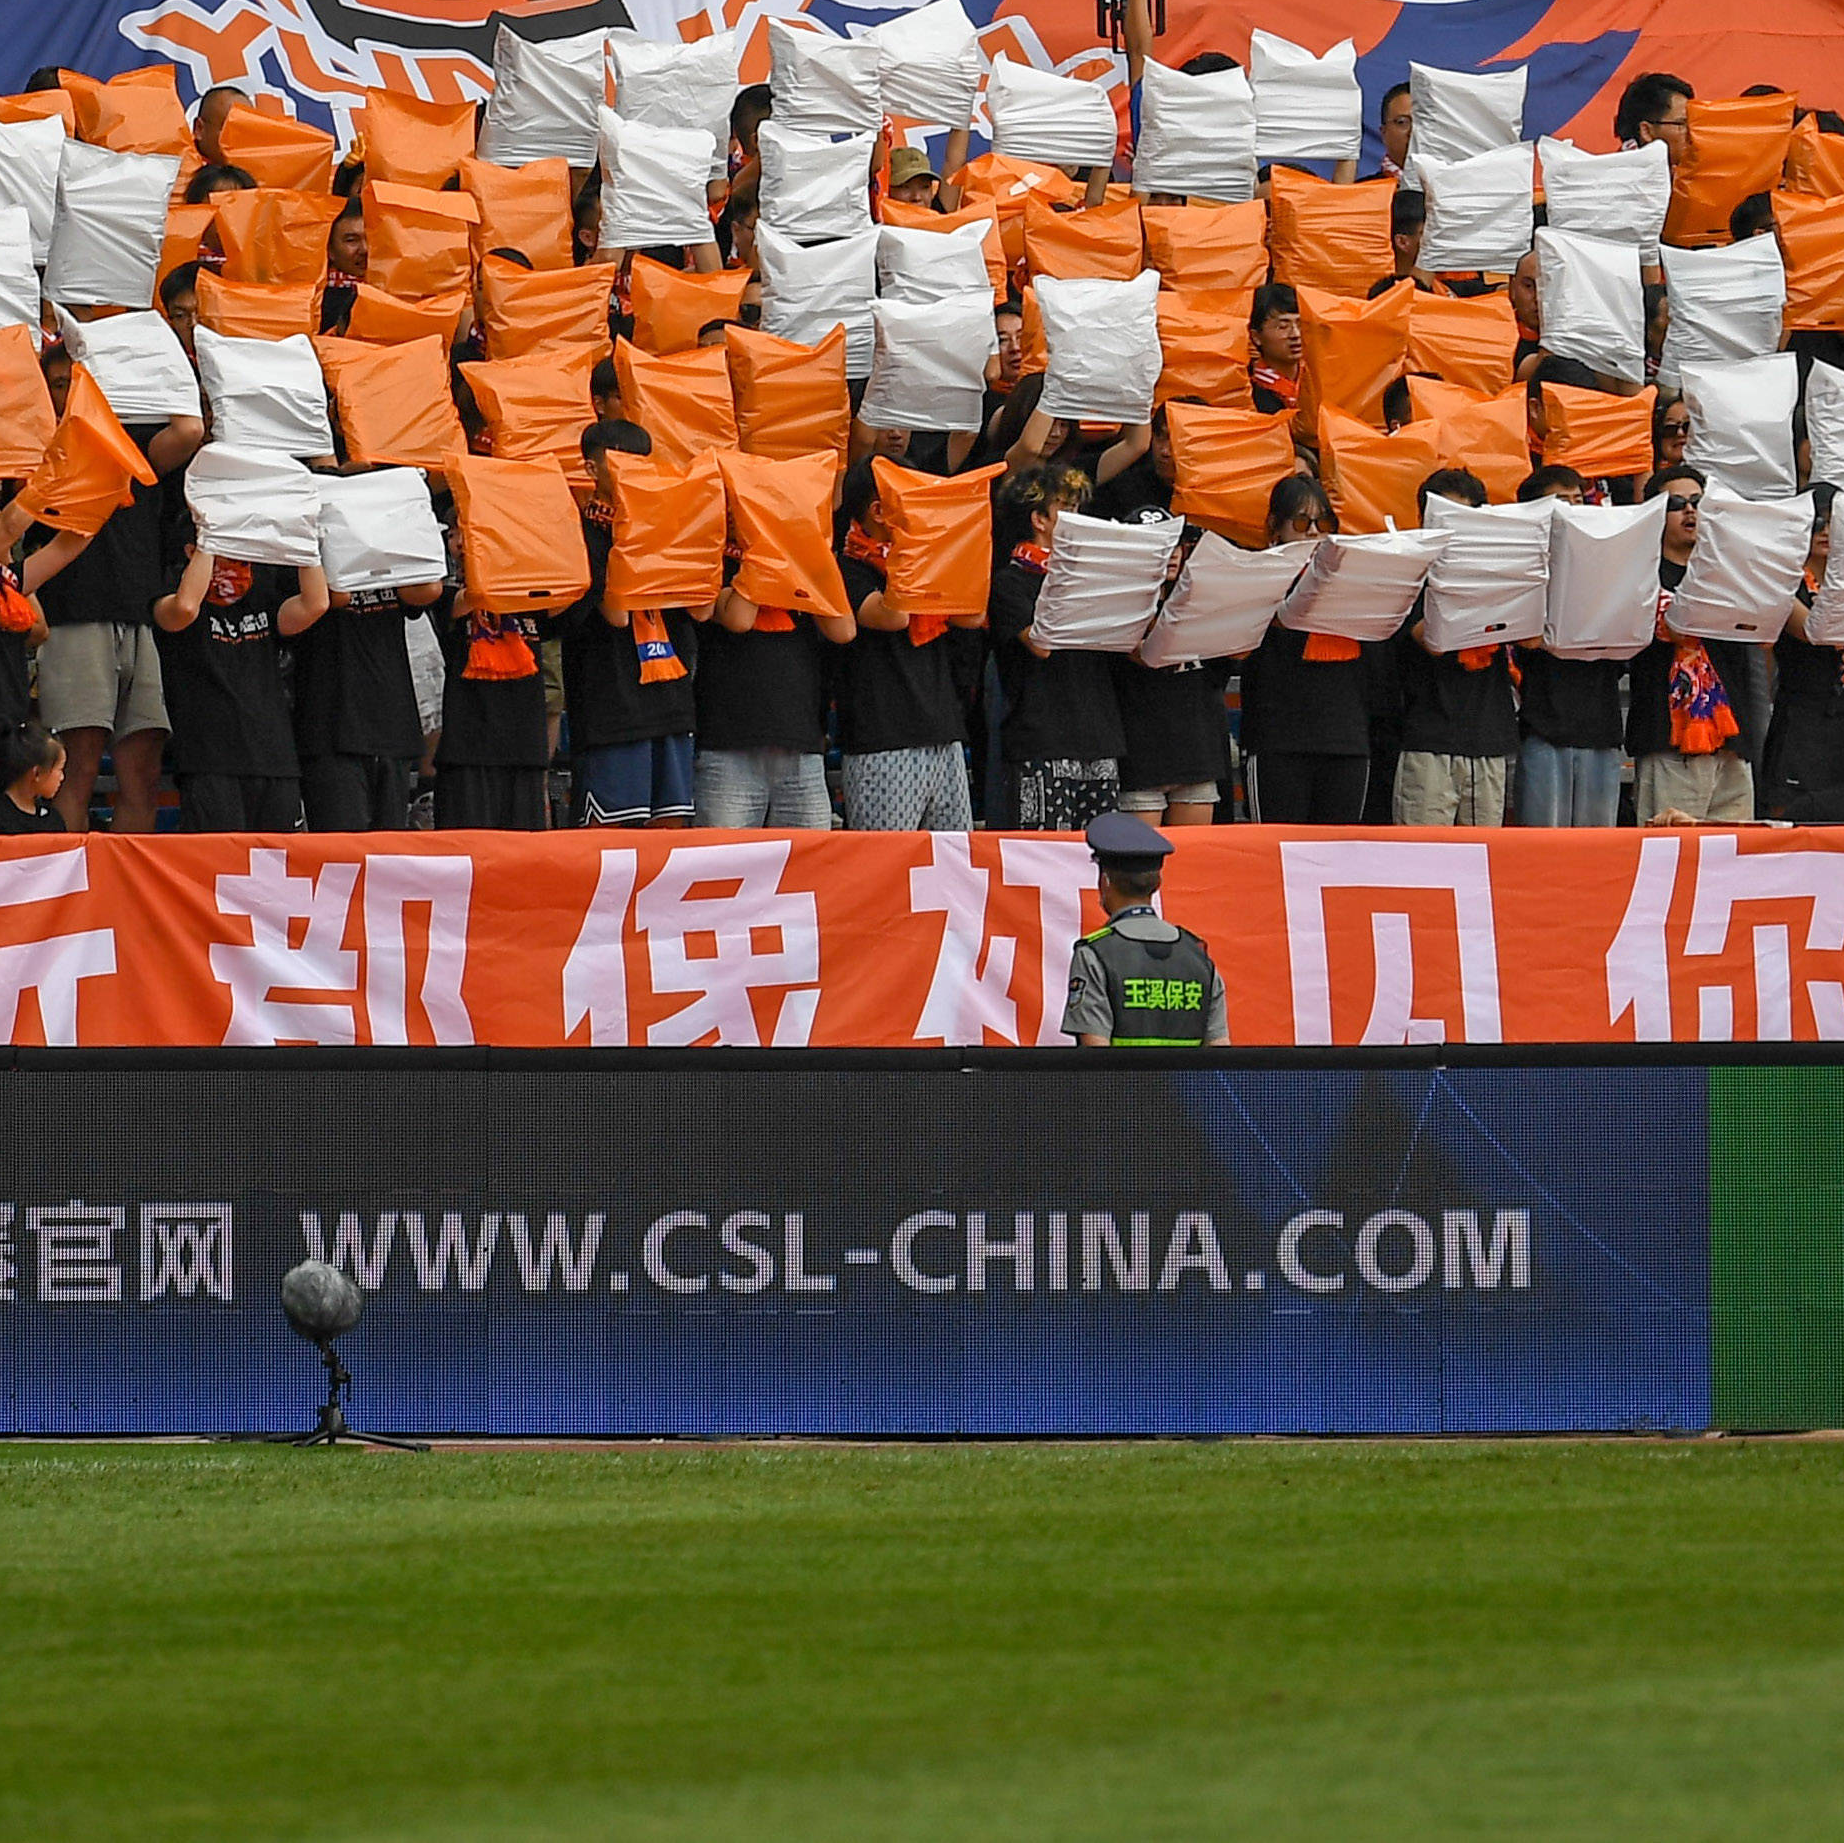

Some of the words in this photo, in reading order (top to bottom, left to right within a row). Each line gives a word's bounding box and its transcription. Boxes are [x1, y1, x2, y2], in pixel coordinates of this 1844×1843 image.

[1123, 978, 1203, 1011] 玉溪保安
[298, 1208, 1533, 1296] WWW.CSL-CHINA.COM
